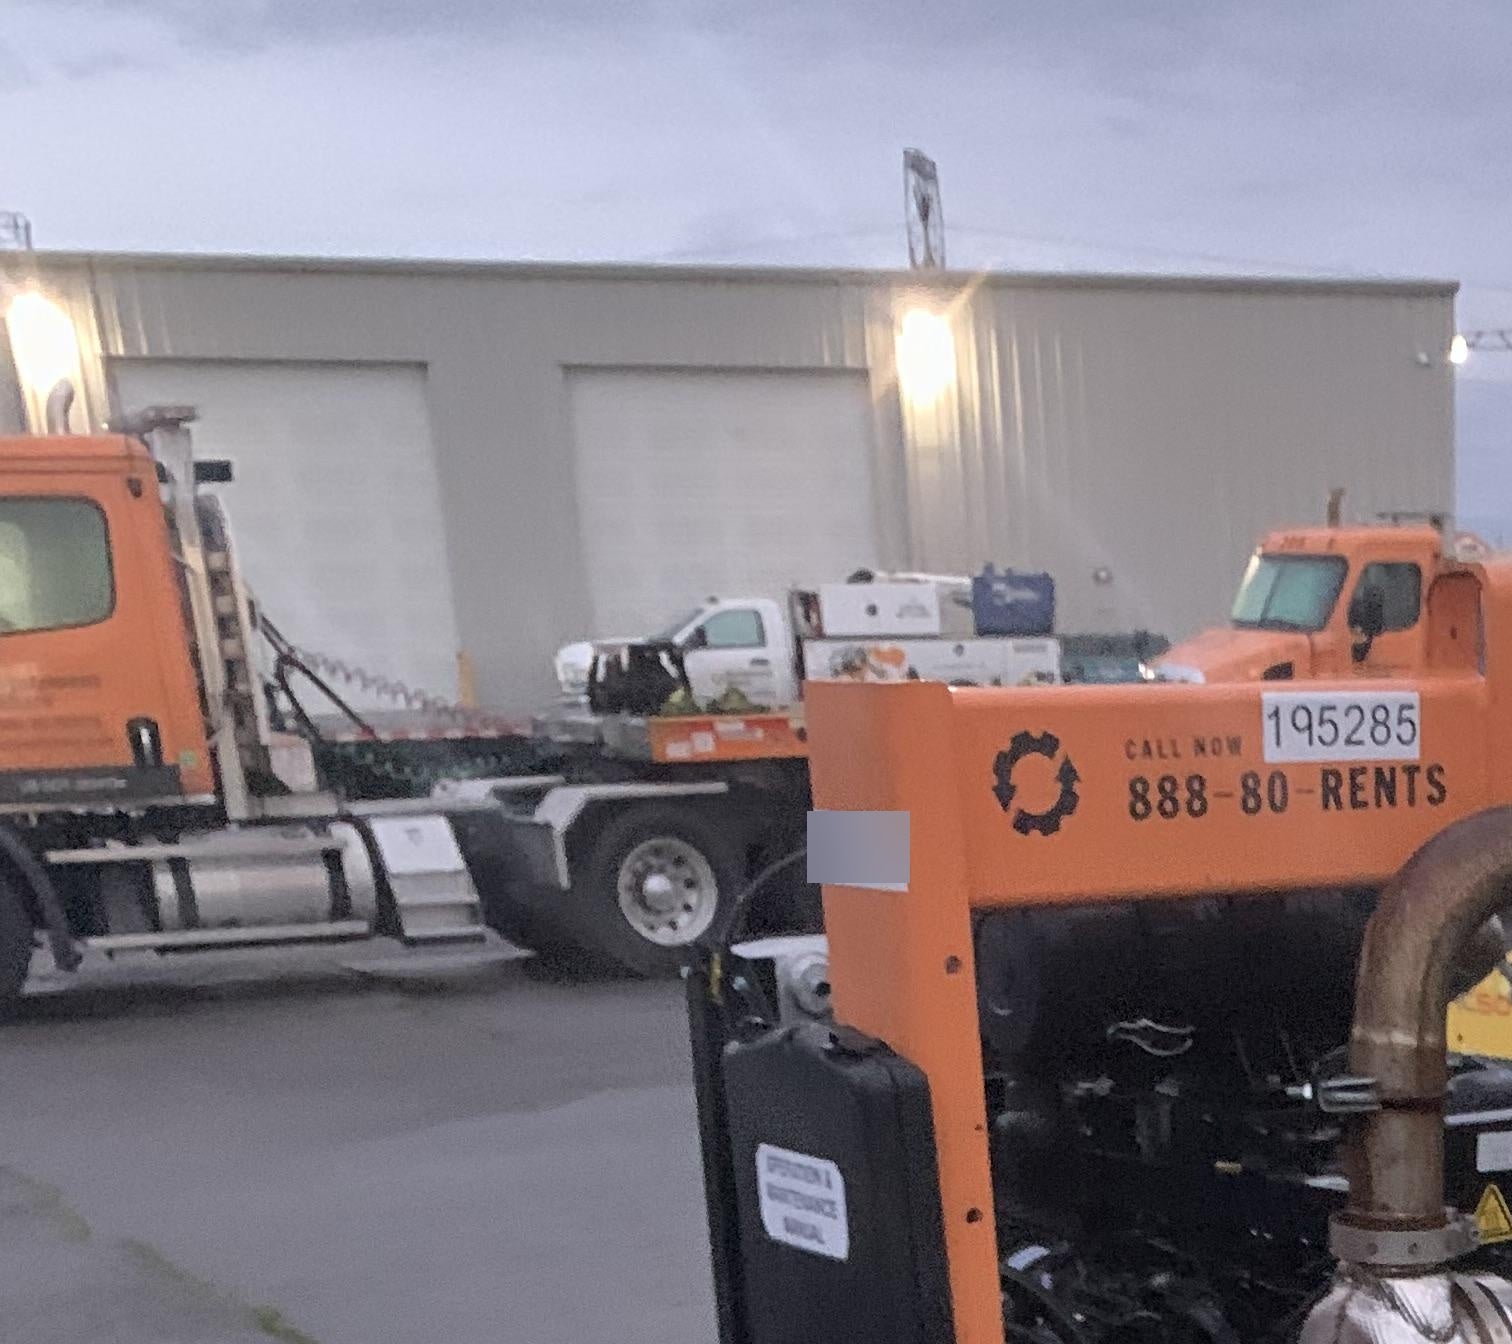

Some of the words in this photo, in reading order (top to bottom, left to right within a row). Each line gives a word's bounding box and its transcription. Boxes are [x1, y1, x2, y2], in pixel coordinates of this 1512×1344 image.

[1124, 738, 1182, 760] CALL
[1194, 735, 1242, 758] NOW
[1266, 703, 1417, 748] 195285
[1128, 763, 1448, 820] 888-80-RENTS
